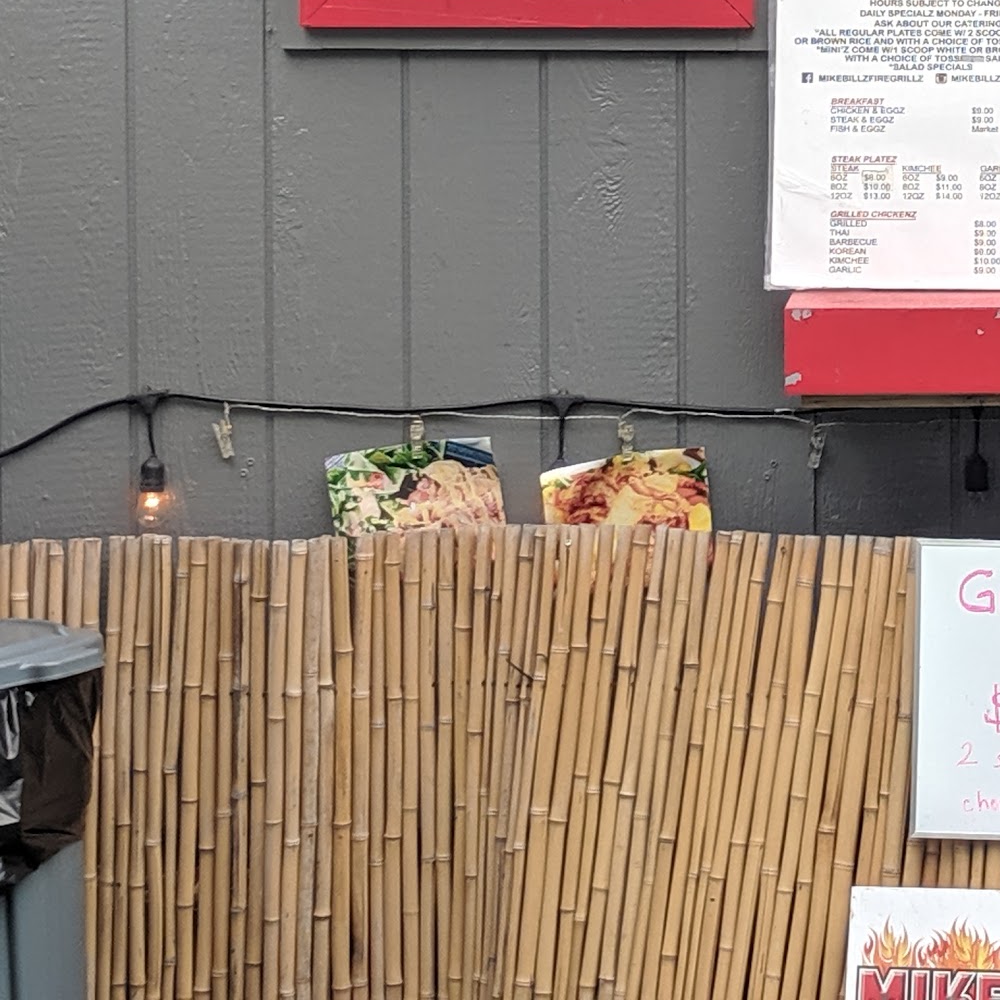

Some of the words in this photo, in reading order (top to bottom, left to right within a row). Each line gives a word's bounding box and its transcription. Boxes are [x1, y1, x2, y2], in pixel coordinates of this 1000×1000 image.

[839, 29, 885, 37] REGULAR
[887, 29, 923, 37] PLATES
[924, 29, 951, 37] COME
[968, 29, 974, 37] 2
[829, 238, 878, 246] BARBECUE
[829, 257, 870, 265] KIMCHEE
[956, 742, 978, 767] 2
